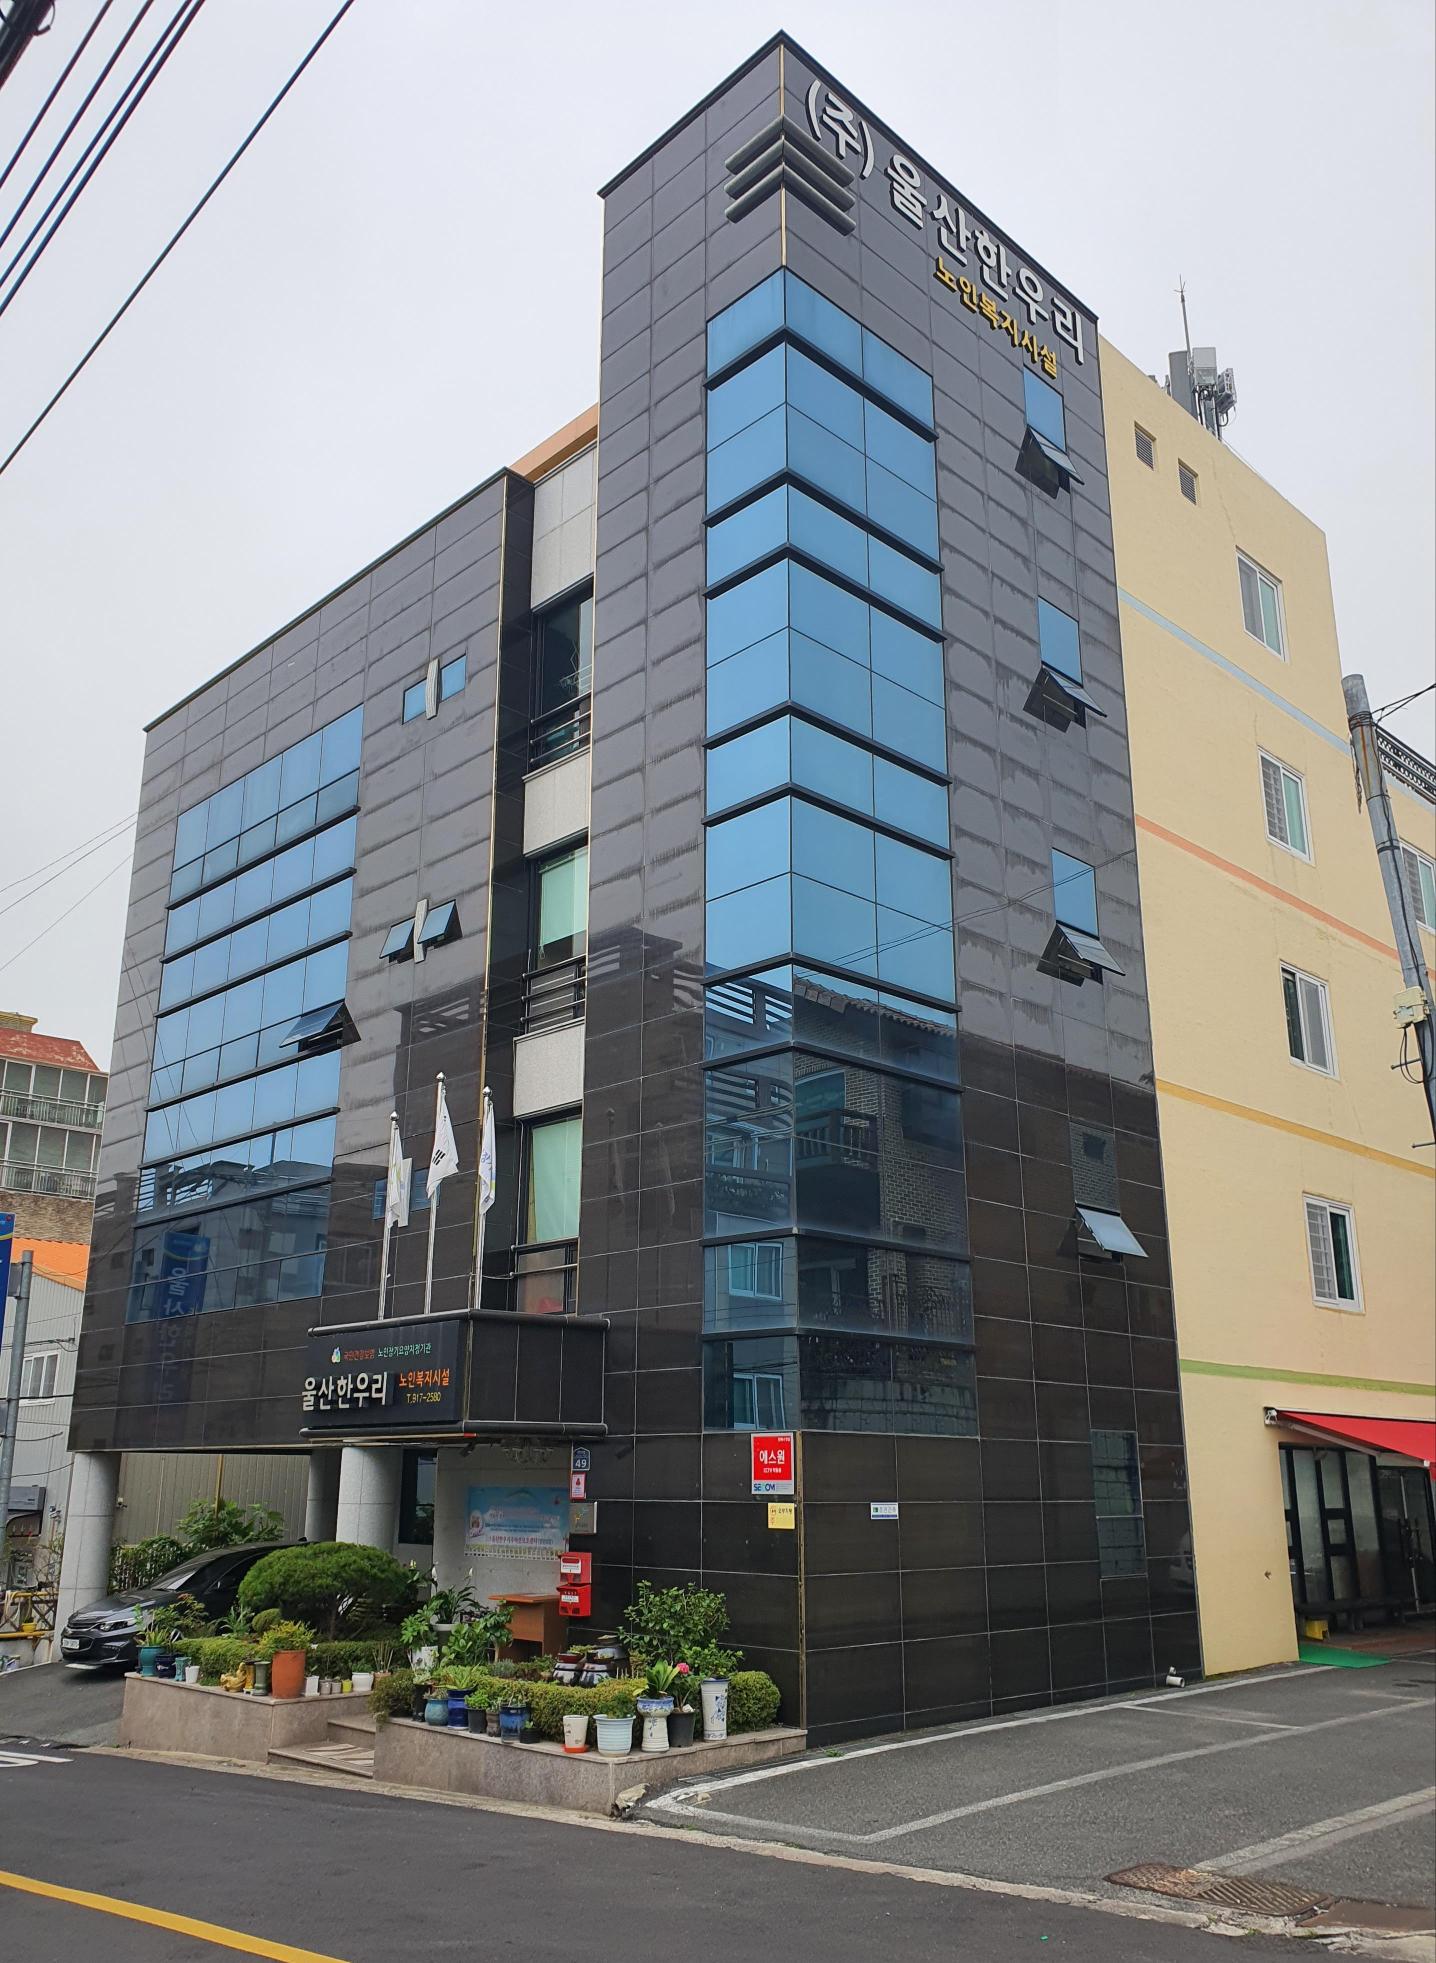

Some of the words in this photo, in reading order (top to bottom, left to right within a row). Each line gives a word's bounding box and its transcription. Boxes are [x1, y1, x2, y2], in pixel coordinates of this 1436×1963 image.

[805, 79, 875, 180] (주)
[885, 154, 1085, 365] 울산한우리
[934, 255, 1058, 380] 노인복지시설
[377, 1342, 432, 1358] 노인장기요양지정기관
[399, 1368, 450, 1388] 노인복지시설
[302, 1372, 387, 1411] 울산한우리
[575, 1459, 587, 1468] 49
[759, 1449, 785, 1465] 에스원
